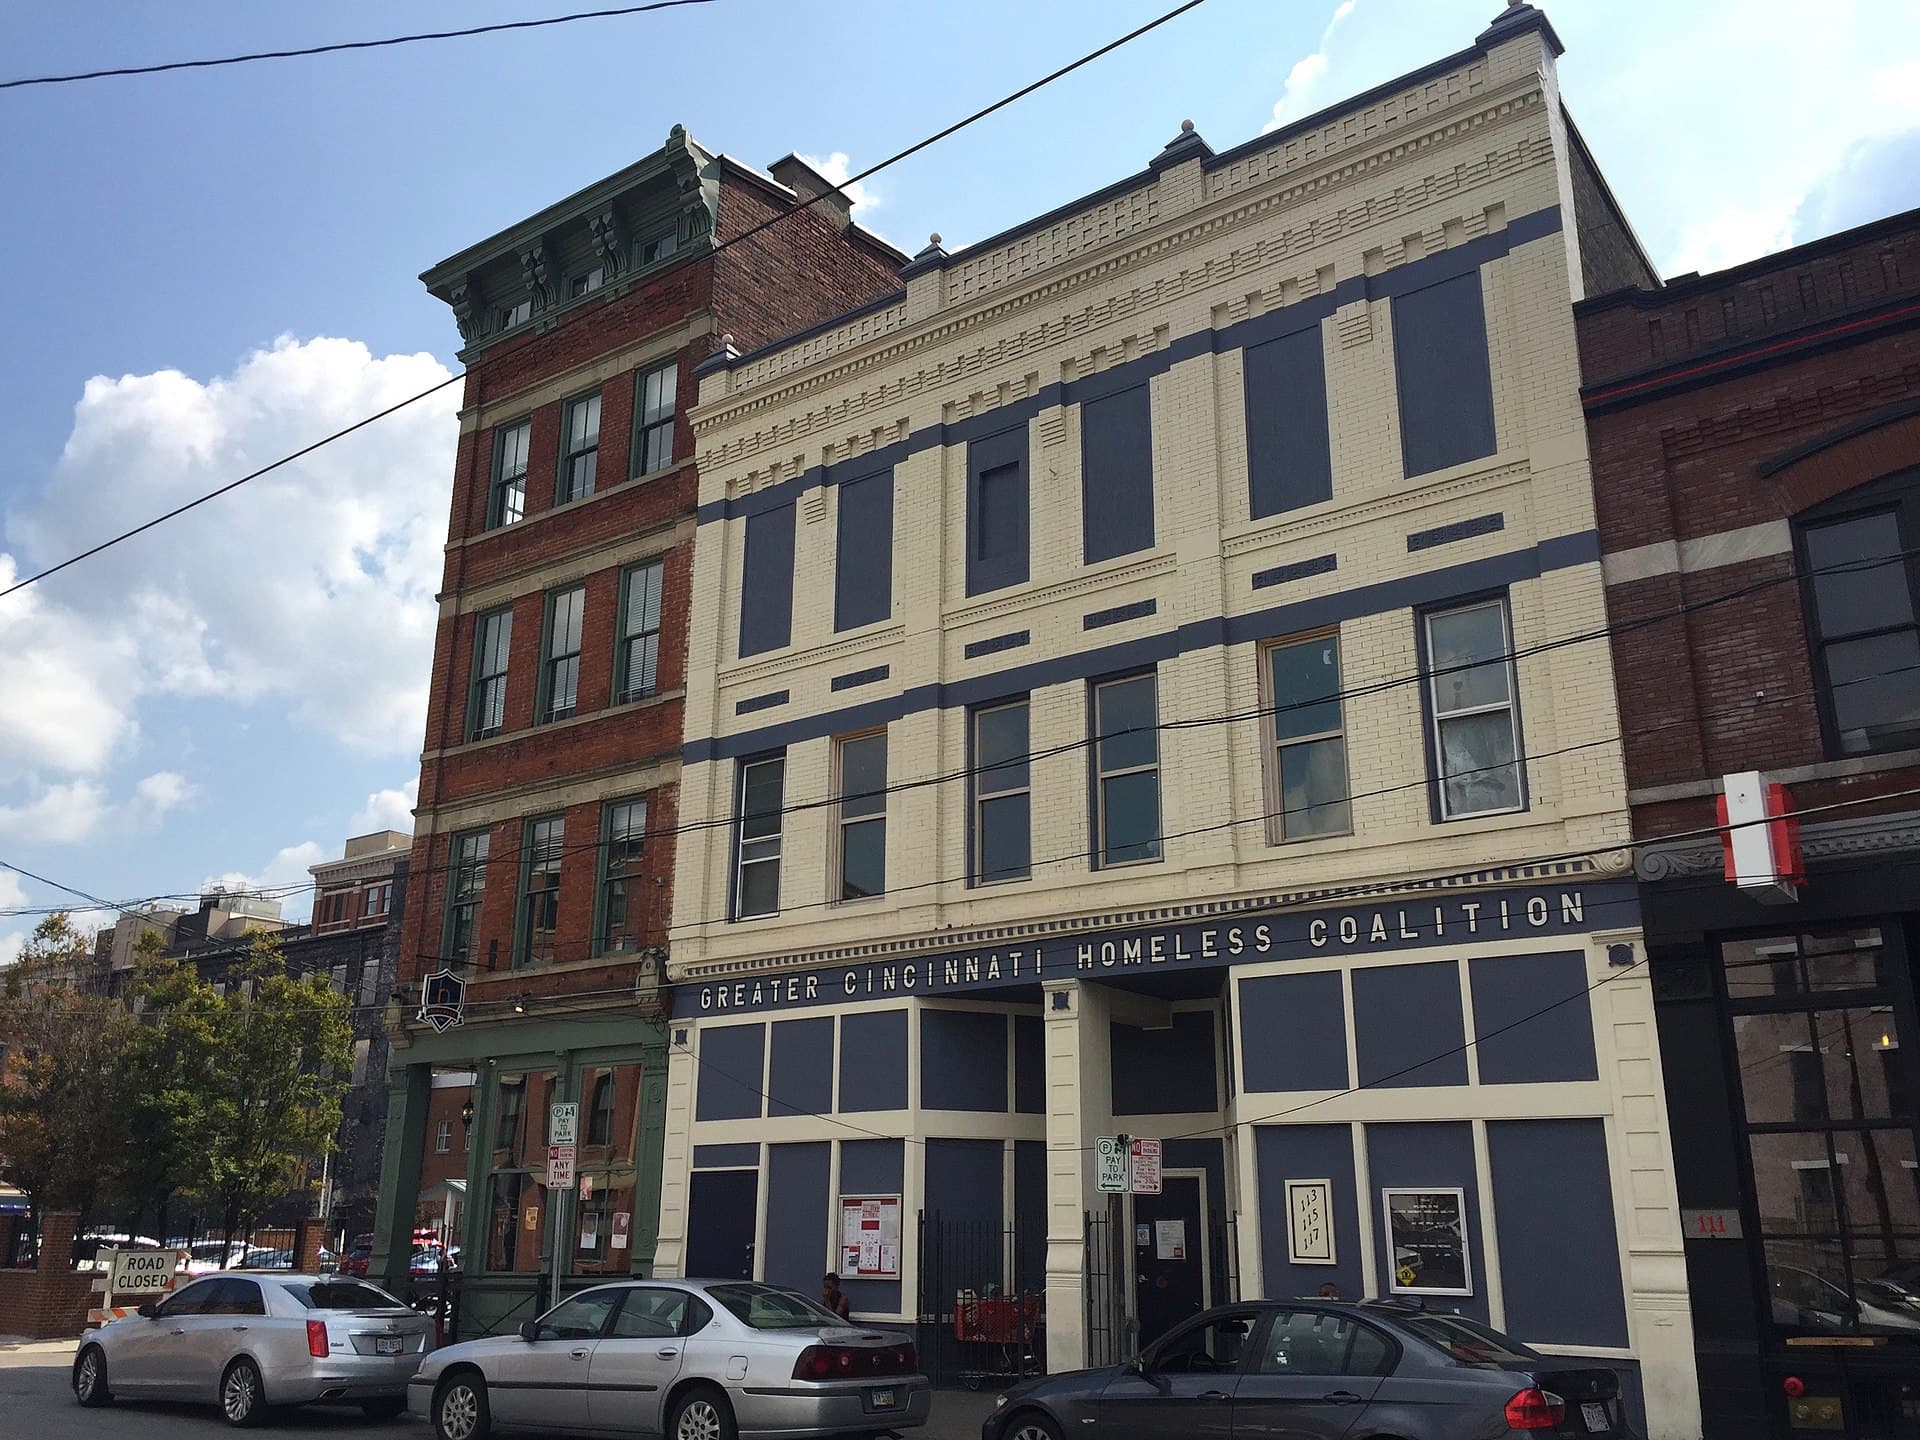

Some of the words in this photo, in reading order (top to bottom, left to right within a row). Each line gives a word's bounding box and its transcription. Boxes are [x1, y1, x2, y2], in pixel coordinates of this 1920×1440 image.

[700, 975, 819, 1010] GREATER
[844, 948, 1044, 995] CINCINNATI
[1076, 924, 1272, 970] HOMELESS
[1309, 892, 1585, 948] COALITION
[554, 1161, 569, 1169] ANY
[1106, 1156, 1121, 1164] PAY
[553, 1171, 569, 1180] TIME
[1108, 1165, 1119, 1173] TO
[1102, 1172, 1125, 1181] PARK
[1301, 1188, 1317, 1212] 113
[1303, 1208, 1319, 1232] 115
[1698, 1215, 1727, 1233] 111
[1304, 1227, 1319, 1251] 117
[127, 1257, 165, 1271] ROAD
[118, 1274, 169, 1289] CLOSED
